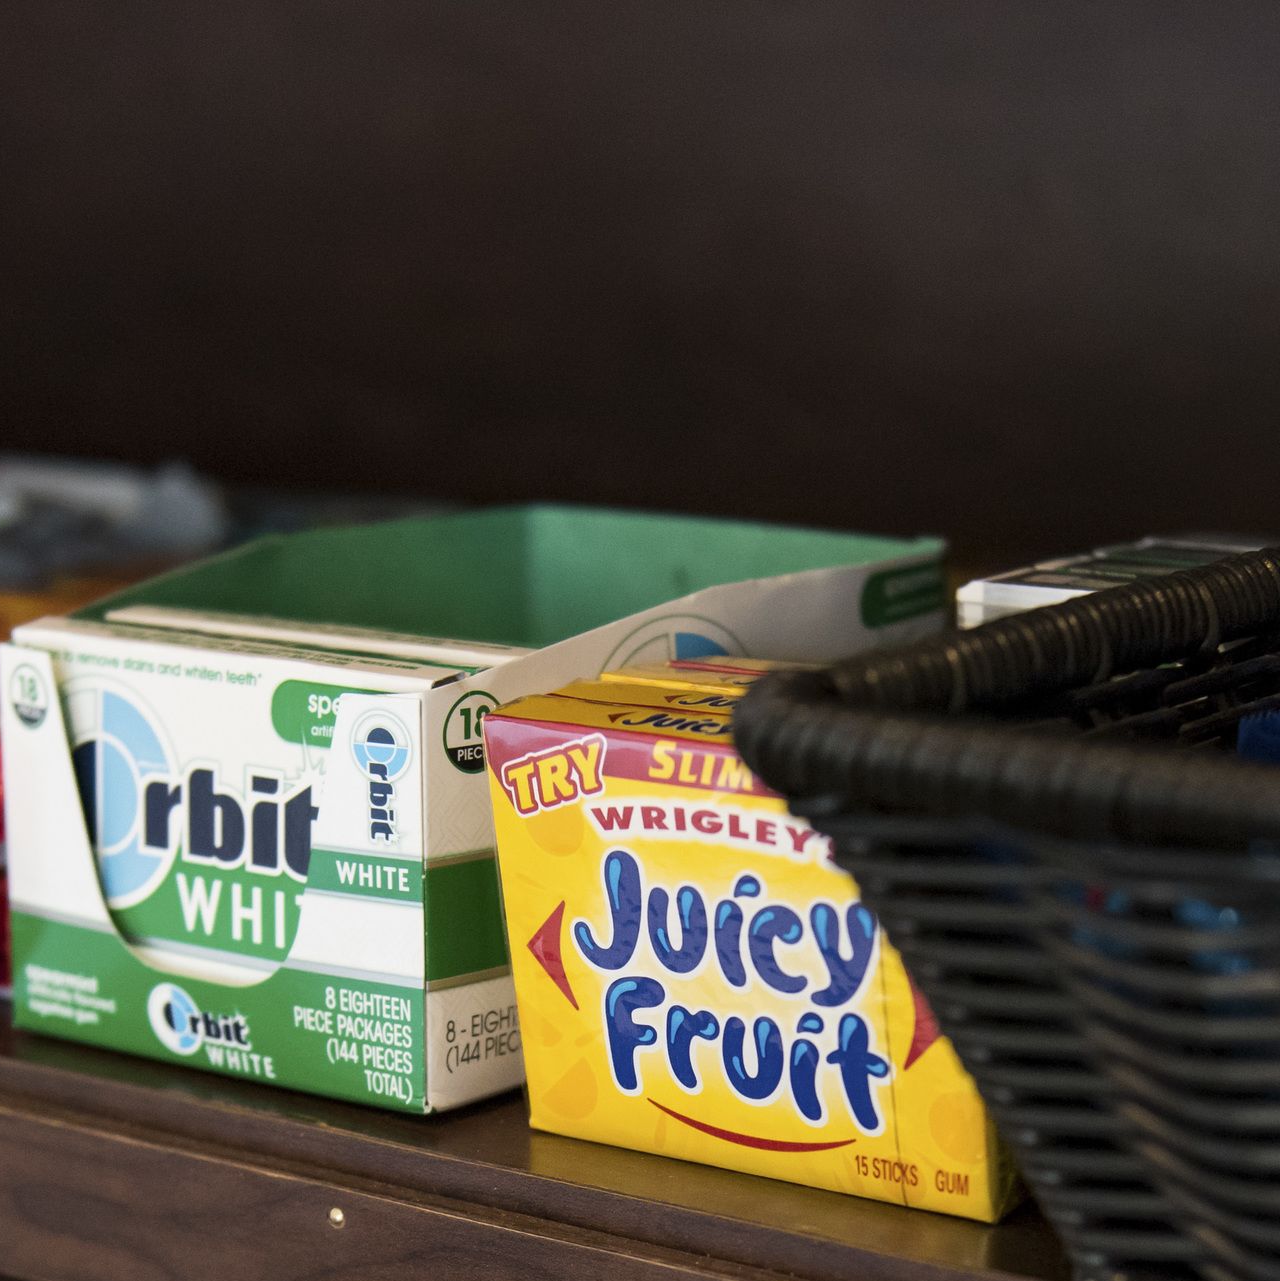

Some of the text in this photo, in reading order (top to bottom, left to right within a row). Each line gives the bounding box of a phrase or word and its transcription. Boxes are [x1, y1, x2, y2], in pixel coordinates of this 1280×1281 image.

[506, 740, 754, 812] TRY SLIM
[591, 805, 834, 864] WRIGLEY
[335, 859, 411, 893] WHITE
[176, 872, 303, 950] WHI
[574, 849, 880, 1008] Juicy
[147, 982, 252, 1057] Orbit
[325, 985, 411, 1022] 8 EIGHTEEN
[293, 1005, 413, 1049] PIECE PACKAGES
[445, 1019, 456, 1043] 8
[204, 1045, 277, 1079] WHITE
[326, 1038, 413, 1075] (144 PIECES
[445, 1039, 481, 1074] (144
[604, 976, 891, 1132] Fruit
[363, 1069, 414, 1105] TOTAL)
[854, 1154, 970, 1196] 15 STICKS GUM
